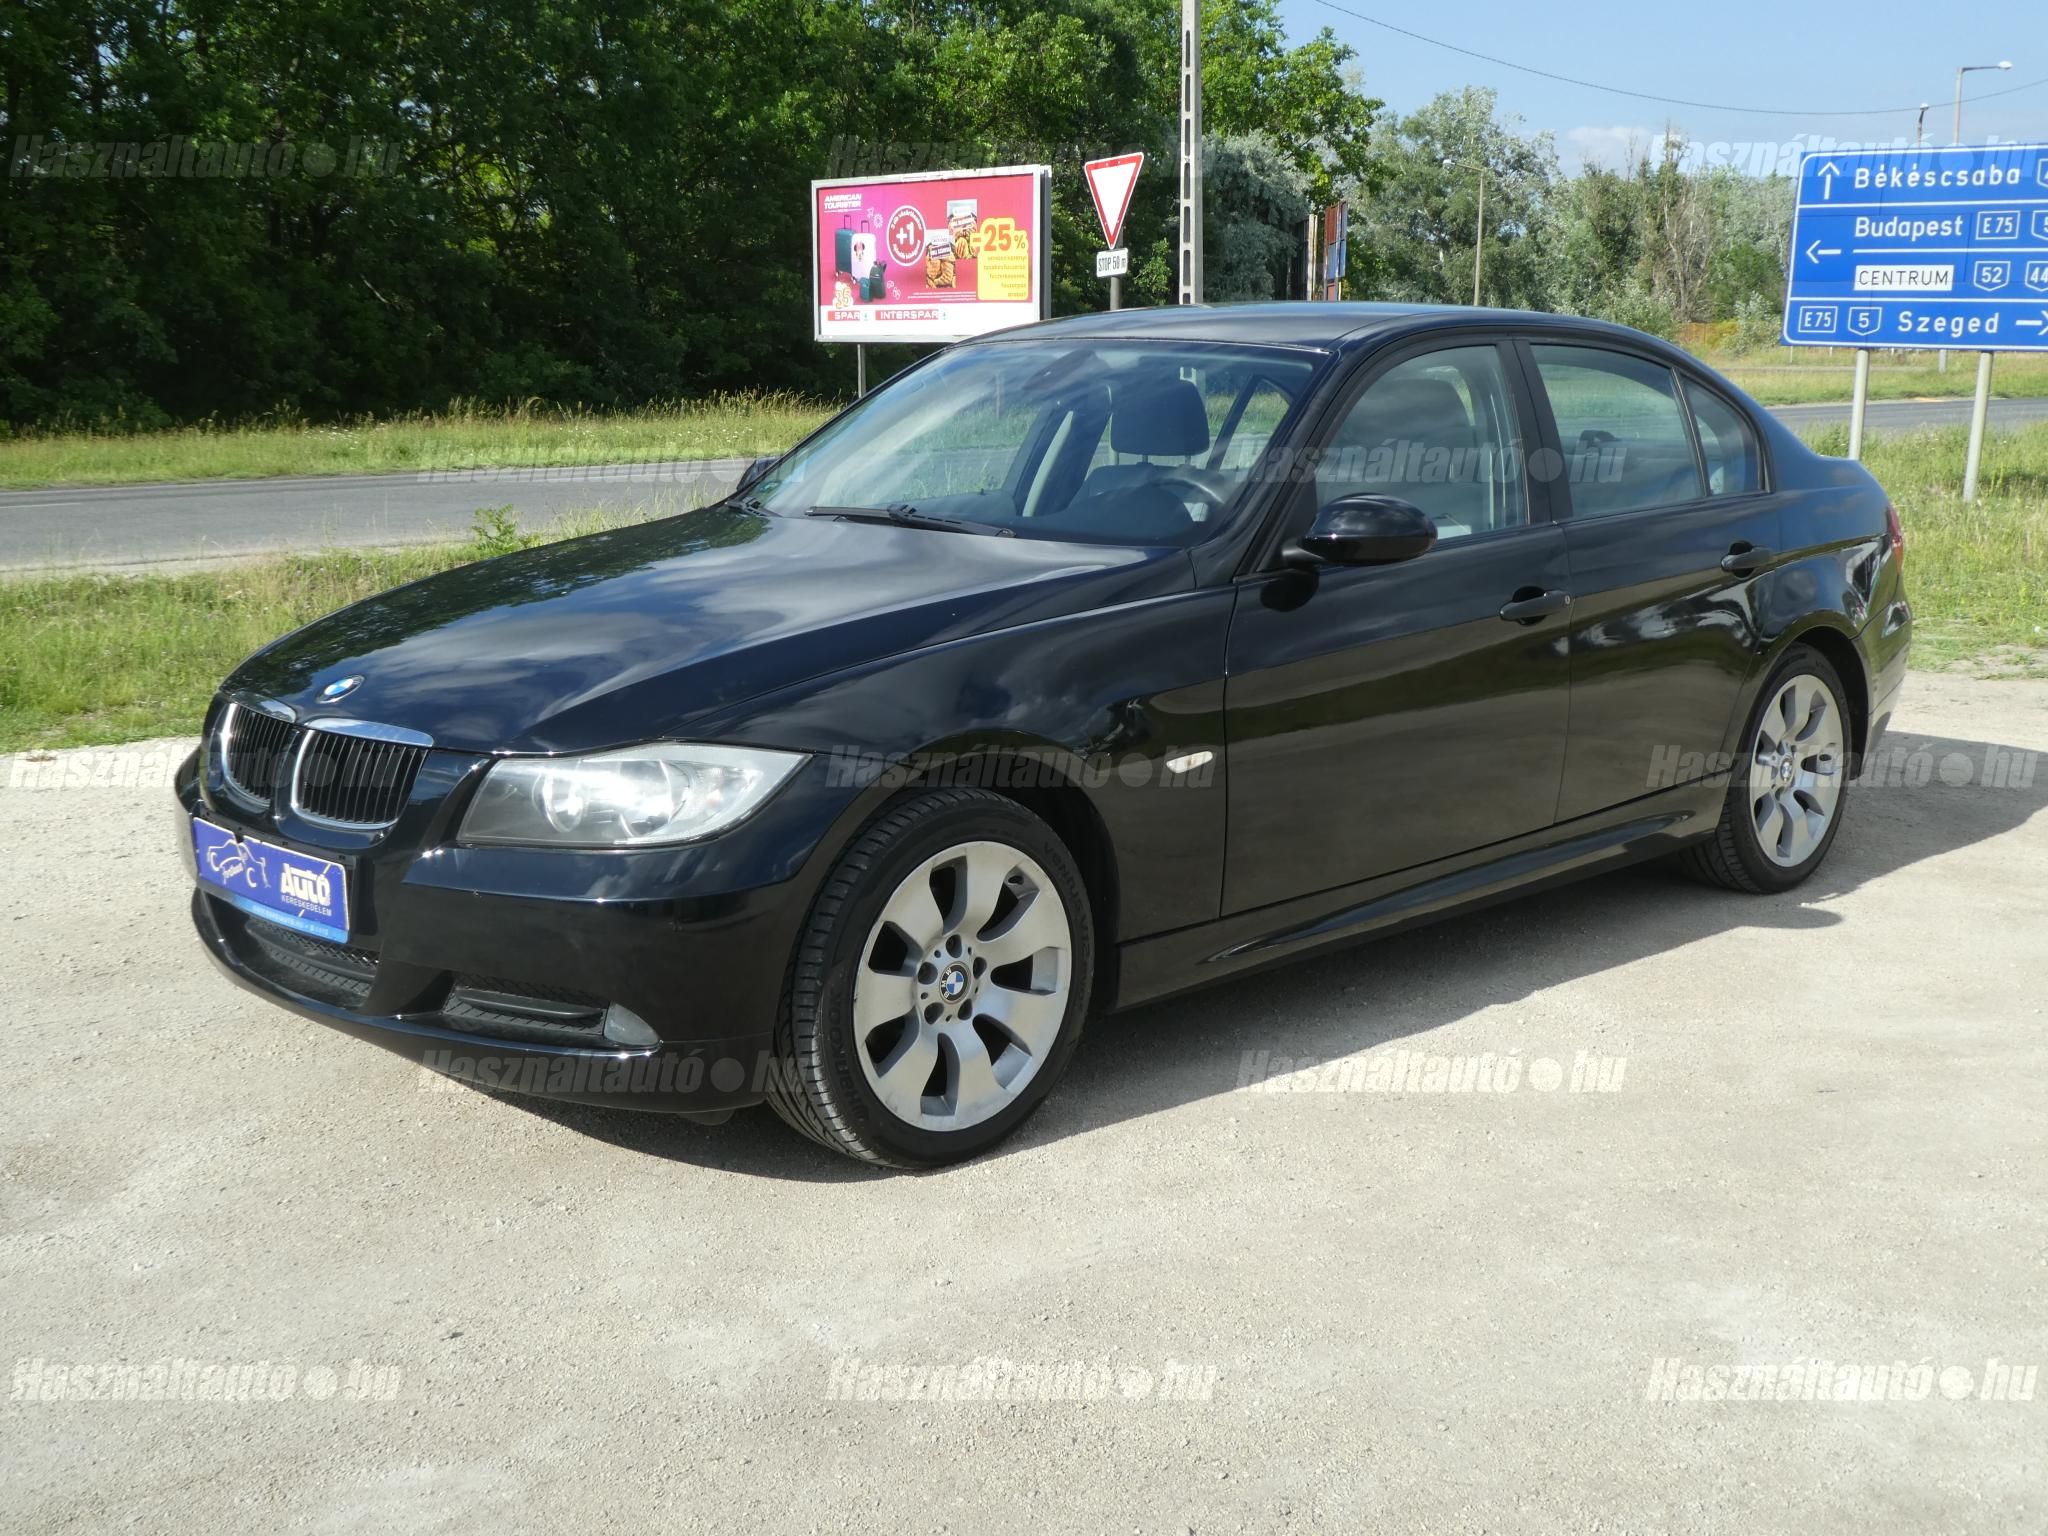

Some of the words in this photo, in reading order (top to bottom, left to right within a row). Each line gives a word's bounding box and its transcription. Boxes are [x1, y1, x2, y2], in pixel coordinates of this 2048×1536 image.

[1854, 163, 2022, 190] Békéscsaba
[824, 201, 862, 210] TOURISTER
[825, 193, 862, 202] AMERICAN
[1854, 214, 1964, 242] Budapest
[1098, 256, 1112, 272] STOP
[1858, 269, 1950, 287] CENTRUM
[1981, 266, 2004, 283] 52
[834, 311, 861, 320] SPAR
[879, 310, 939, 320] INTERSPAR
[1858, 312, 1870, 328] 5
[1897, 311, 2000, 339] Szeged
